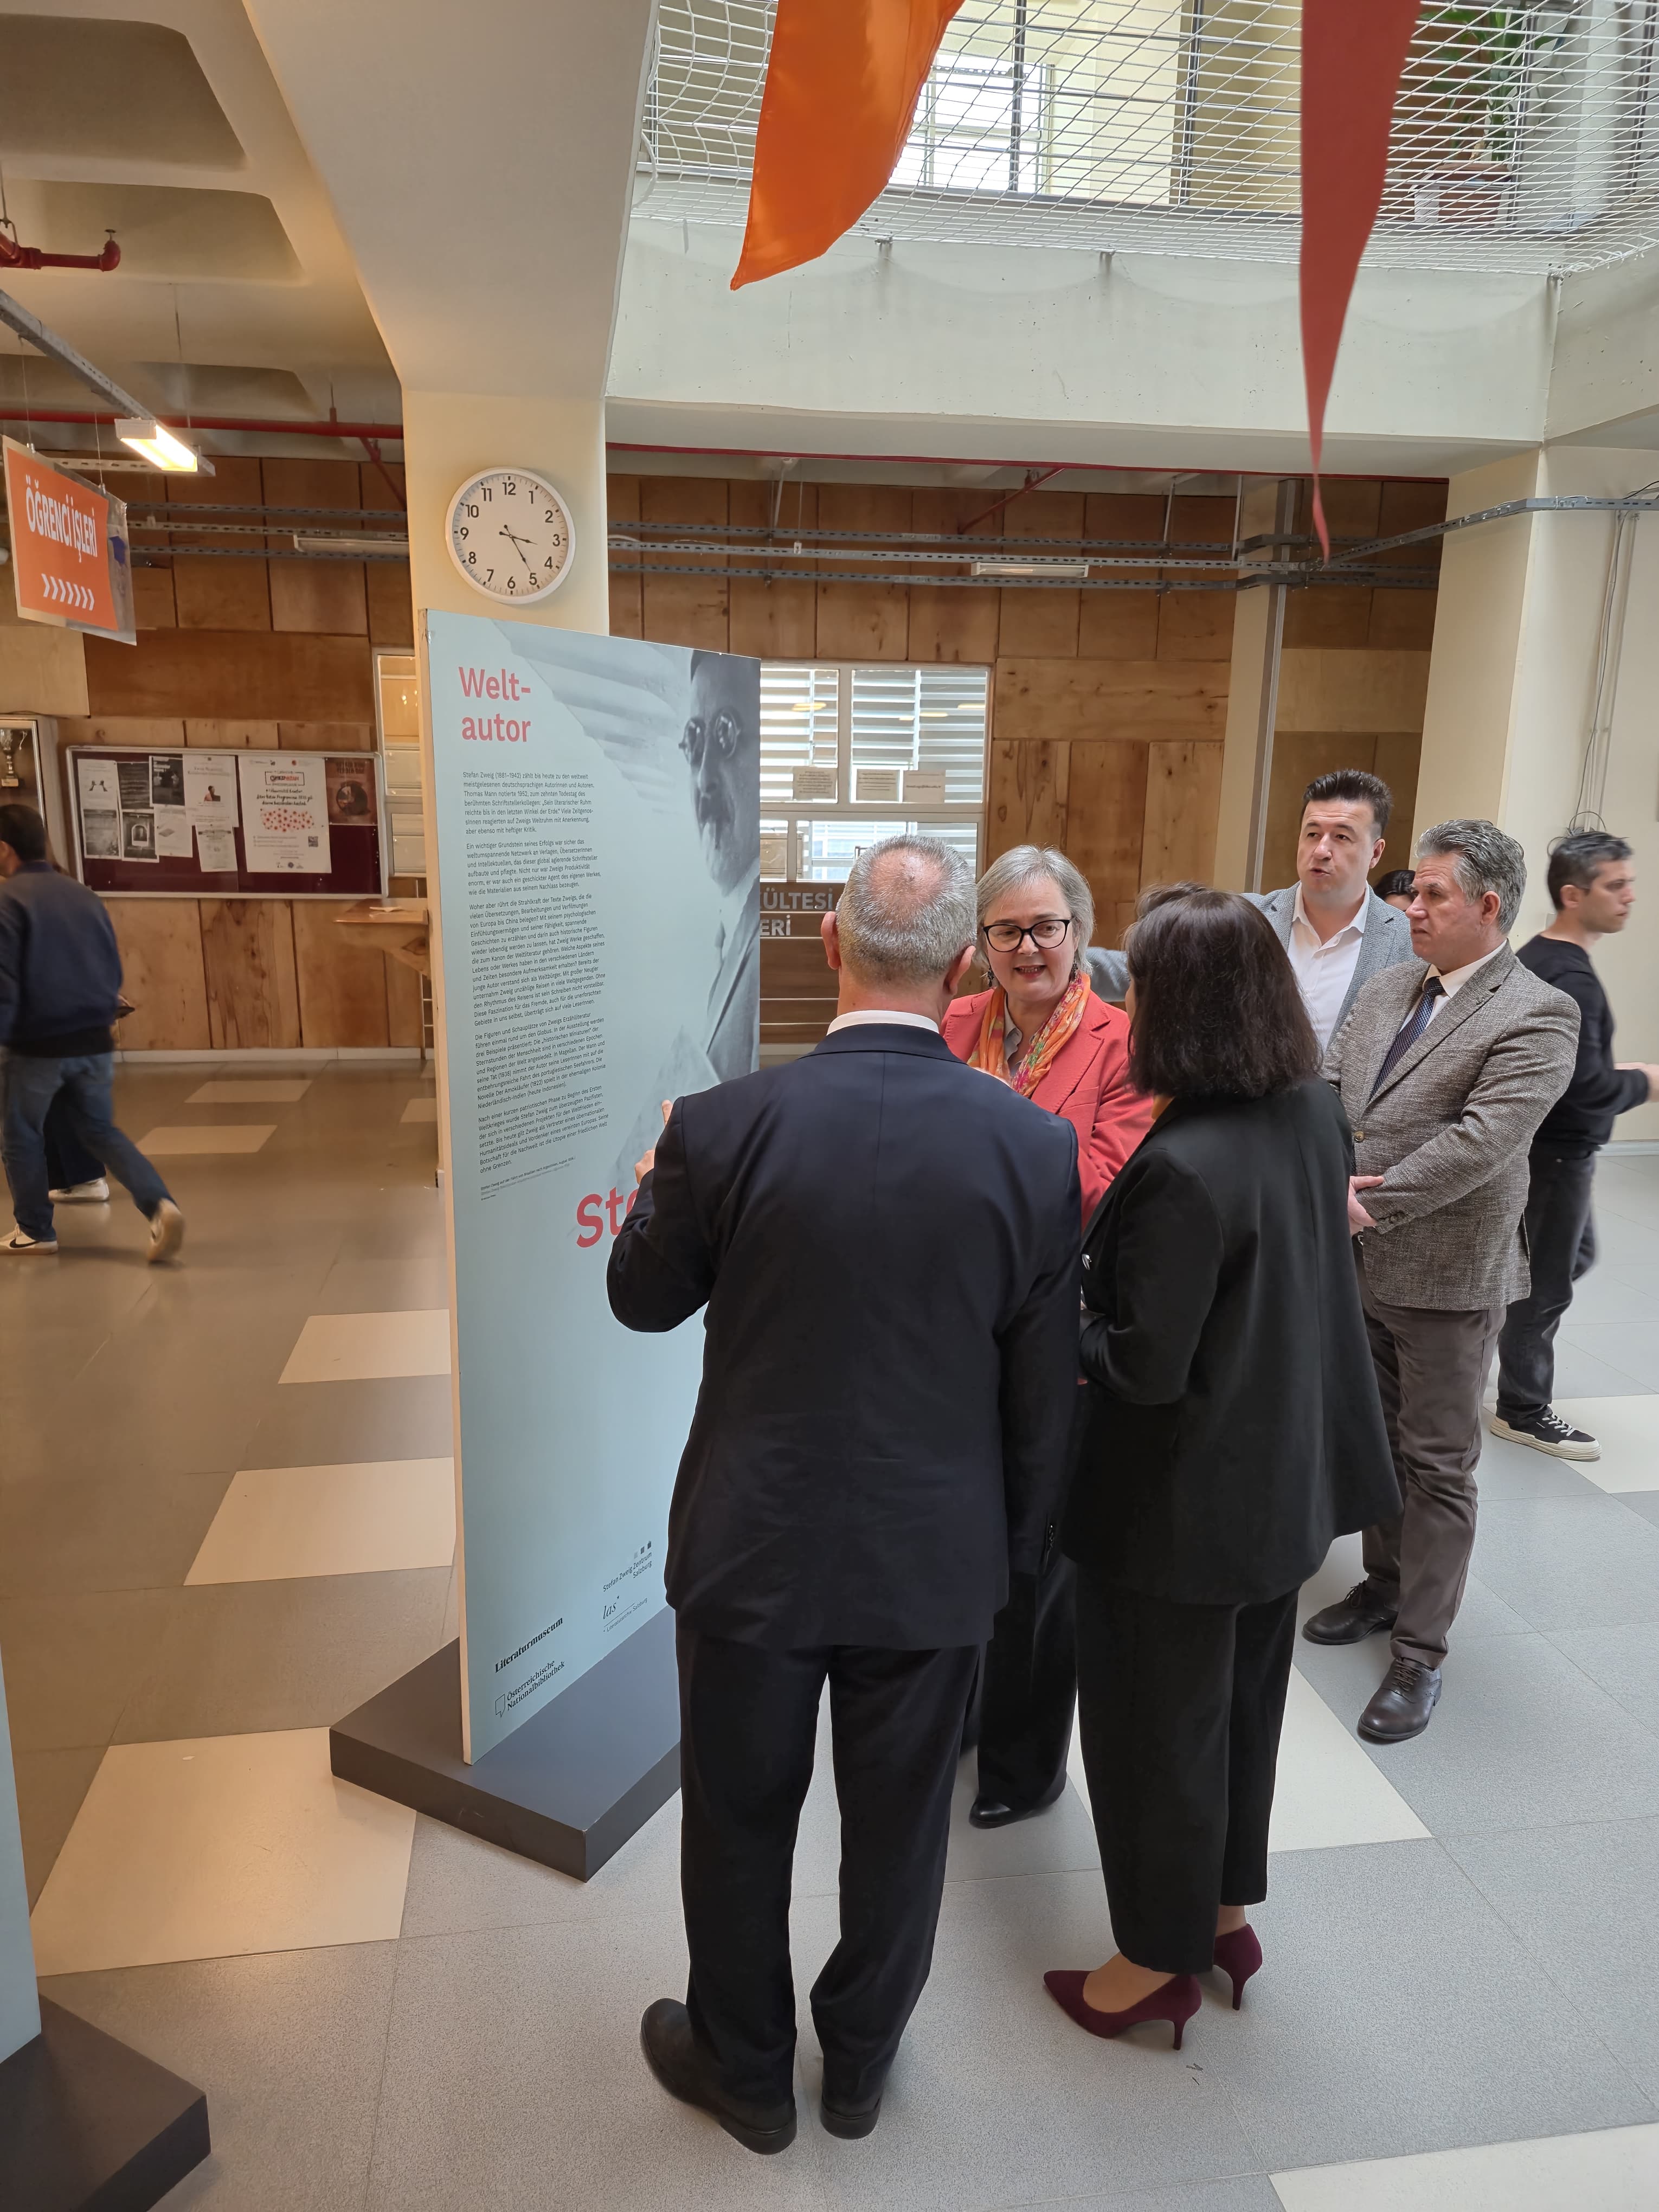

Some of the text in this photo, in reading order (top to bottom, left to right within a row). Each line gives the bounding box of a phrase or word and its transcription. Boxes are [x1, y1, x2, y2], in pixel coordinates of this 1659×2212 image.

[481, 487, 492, 502] 11
[502, 482, 516, 496] 12
[529, 490, 534, 504] 1
[465, 504, 479, 518] 10
[545, 510, 554, 523] 2
[26, 474, 98, 563] ÖĞRENCİ İŞLERİ
[460, 527, 469, 541] 9
[552, 533, 561, 547] 3
[468, 551, 477, 564] 8
[544, 556, 553, 569] 4
[486, 569, 494, 582] 7
[507, 576, 516, 589] 6
[529, 573, 537, 586] 5
[459, 666, 531, 702] Welt-
[462, 713, 531, 743] autor
[480, 771, 494, 780] Zweig
[467, 851, 510, 859] weltumspannende
[478, 859, 513, 867] Intellektuellen,
[537, 857, 550, 865] global
[551, 856, 571, 864] agierende
[522, 875, 547, 884] geschickter
[518, 898, 542, 906] Strahlkraft
[760, 887, 833, 910] ÜLTESİ
[485, 910, 520, 918] Übersetzungen,
[471, 927, 520, 937] Einfühlungsvermögen
[544, 921, 564, 929] Fähigkeit,
[565, 918, 587, 927] spannende
[527, 1089, 542, 1097] (heute
[492, 1160, 512, 1169] Grenzen.
[603, 1552, 652, 1592] Stefan Zweig Zentrum
[633, 1560, 652, 1579] Salzburg
[633, 1597, 648, 1612] Salzburg
[495, 1617, 563, 1674] Literaturmuseum
[507, 1660, 555, 1701] Österreichische
[507, 1661, 565, 1711] Nationalbibliothek
